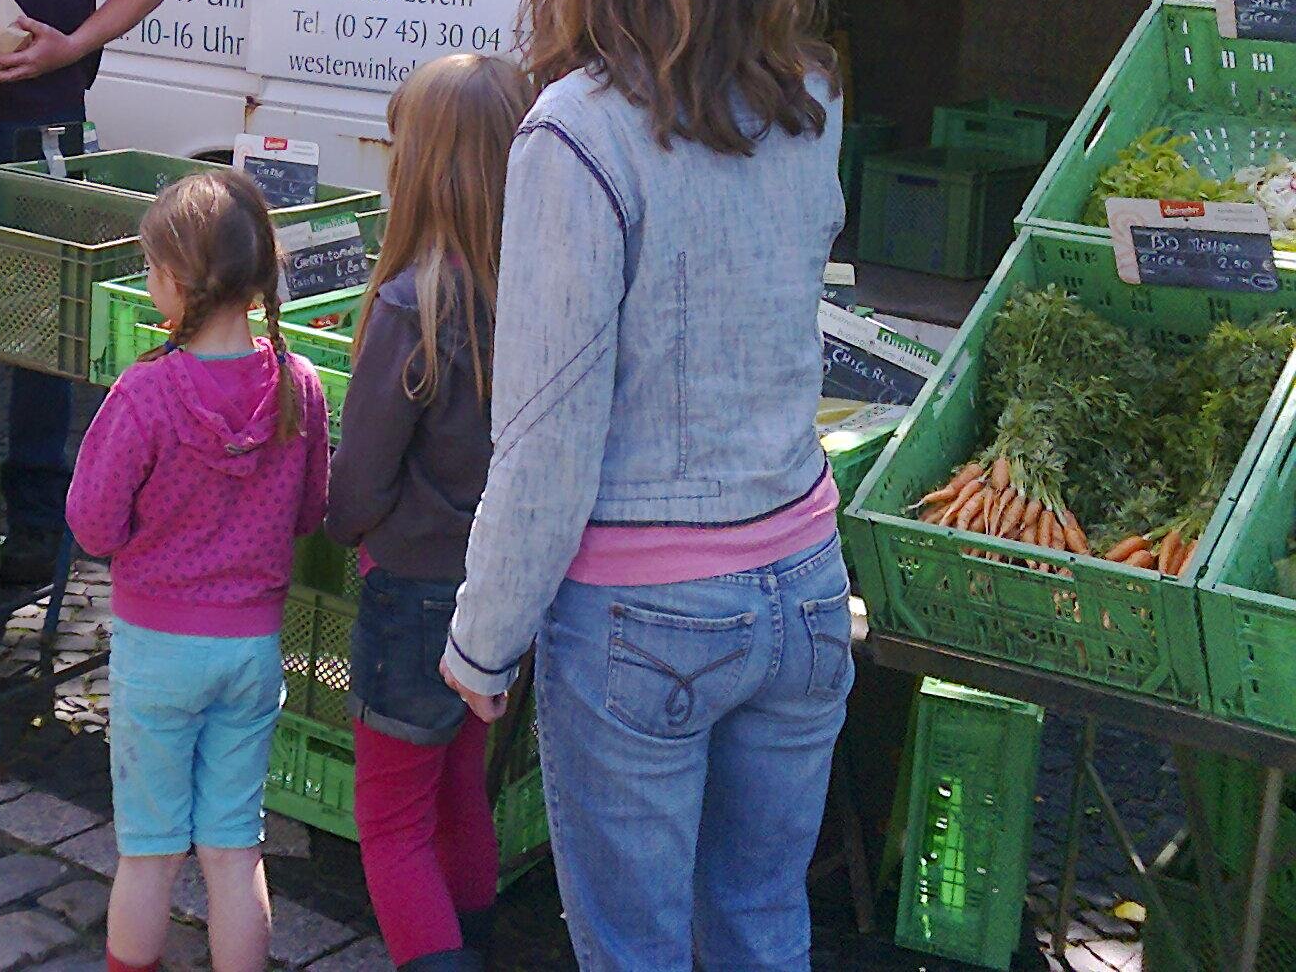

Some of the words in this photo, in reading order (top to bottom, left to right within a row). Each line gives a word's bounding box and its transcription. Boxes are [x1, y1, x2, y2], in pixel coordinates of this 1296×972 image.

[141, 18, 194, 50] 10-16
[203, 24, 246, 56] Uhr
[292, 9, 326, 35] Tel.
[335, 13, 357, 41] (0
[363, 15, 389, 40] 57
[394, 19, 428, 49] 45)
[435, 22, 464, 49] 30
[471, 25, 502, 52] 04
